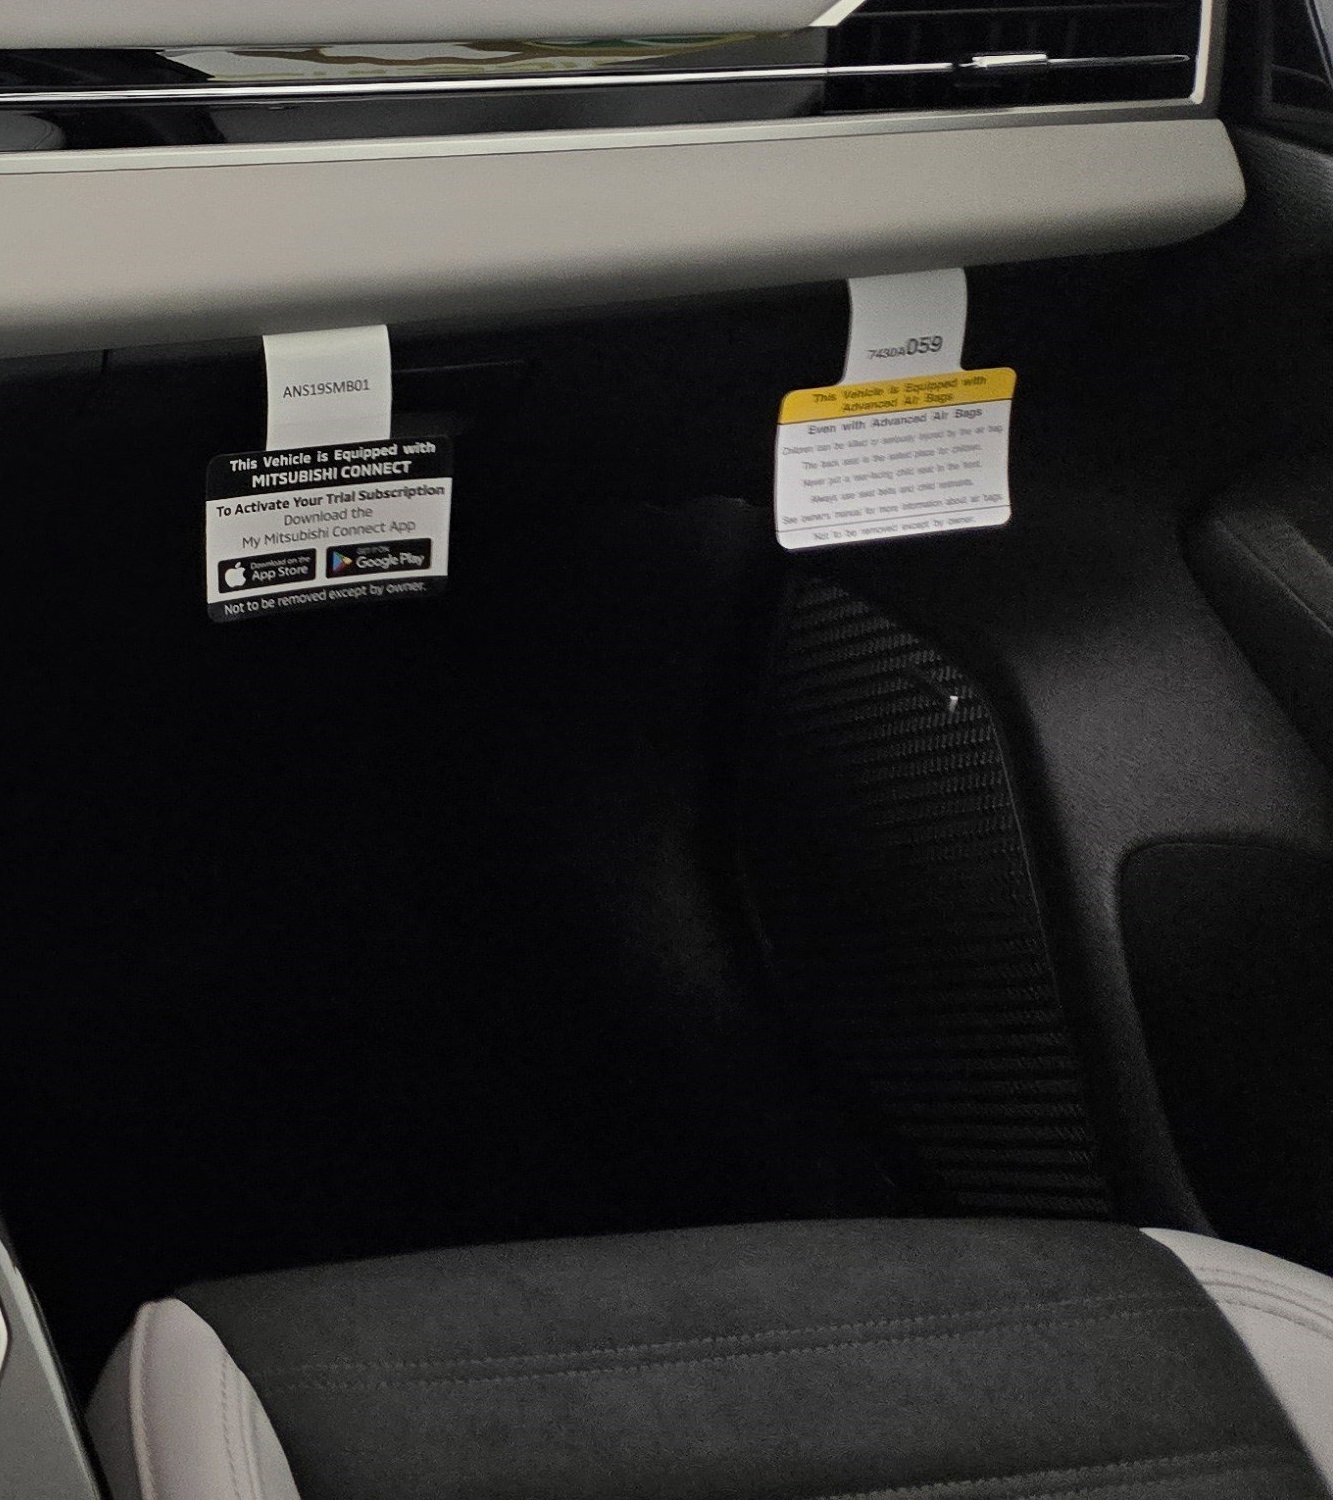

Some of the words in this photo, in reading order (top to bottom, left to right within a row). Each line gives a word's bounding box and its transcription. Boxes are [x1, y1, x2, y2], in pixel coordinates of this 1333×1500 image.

[282, 379, 370, 399] ANS19SMB01
[813, 393, 837, 403] This
[843, 387, 884, 399] Vehicle
[889, 386, 899, 394] is
[904, 378, 958, 394] Equipped
[962, 375, 987, 386] with
[843, 398, 898, 412] Advanced
[905, 395, 920, 405] Air
[925, 393, 953, 405] Bags
[808, 424, 836, 435] Even
[842, 420, 866, 431] with
[871, 414, 927, 428] Advanced
[933, 411, 949, 421] Air
[954, 408, 983, 420] Bags
[230, 458, 258, 472] This
[263, 453, 311, 468] Vehicle
[317, 451, 328, 462] is
[334, 444, 398, 462] Equipped
[402, 441, 436, 455] with
[252, 467, 338, 488] MITSUBISHI
[340, 460, 412, 478] CONNECT
[216, 506, 232, 517] To
[235, 500, 290, 515] Activate
[293, 496, 324, 508] Your
[326, 490, 355, 504] Trial
[358, 485, 445, 501] Subscription
[284, 509, 347, 526] Download
[351, 507, 374, 519] the
[242, 536, 261, 549] My
[264, 527, 329, 545] Mitsubishi
[333, 522, 386, 538] Connect
[389, 520, 416, 535] App
[251, 570, 276, 581] App
[278, 564, 309, 577] Store
[355, 553, 399, 569] Google
[399, 552, 425, 566] Play
[224, 602, 245, 616] Not
[247, 600, 259, 612] to
[261, 597, 275, 609] be
[277, 589, 327, 606] removed
[328, 585, 367, 600] except
[369, 583, 384, 596] by
